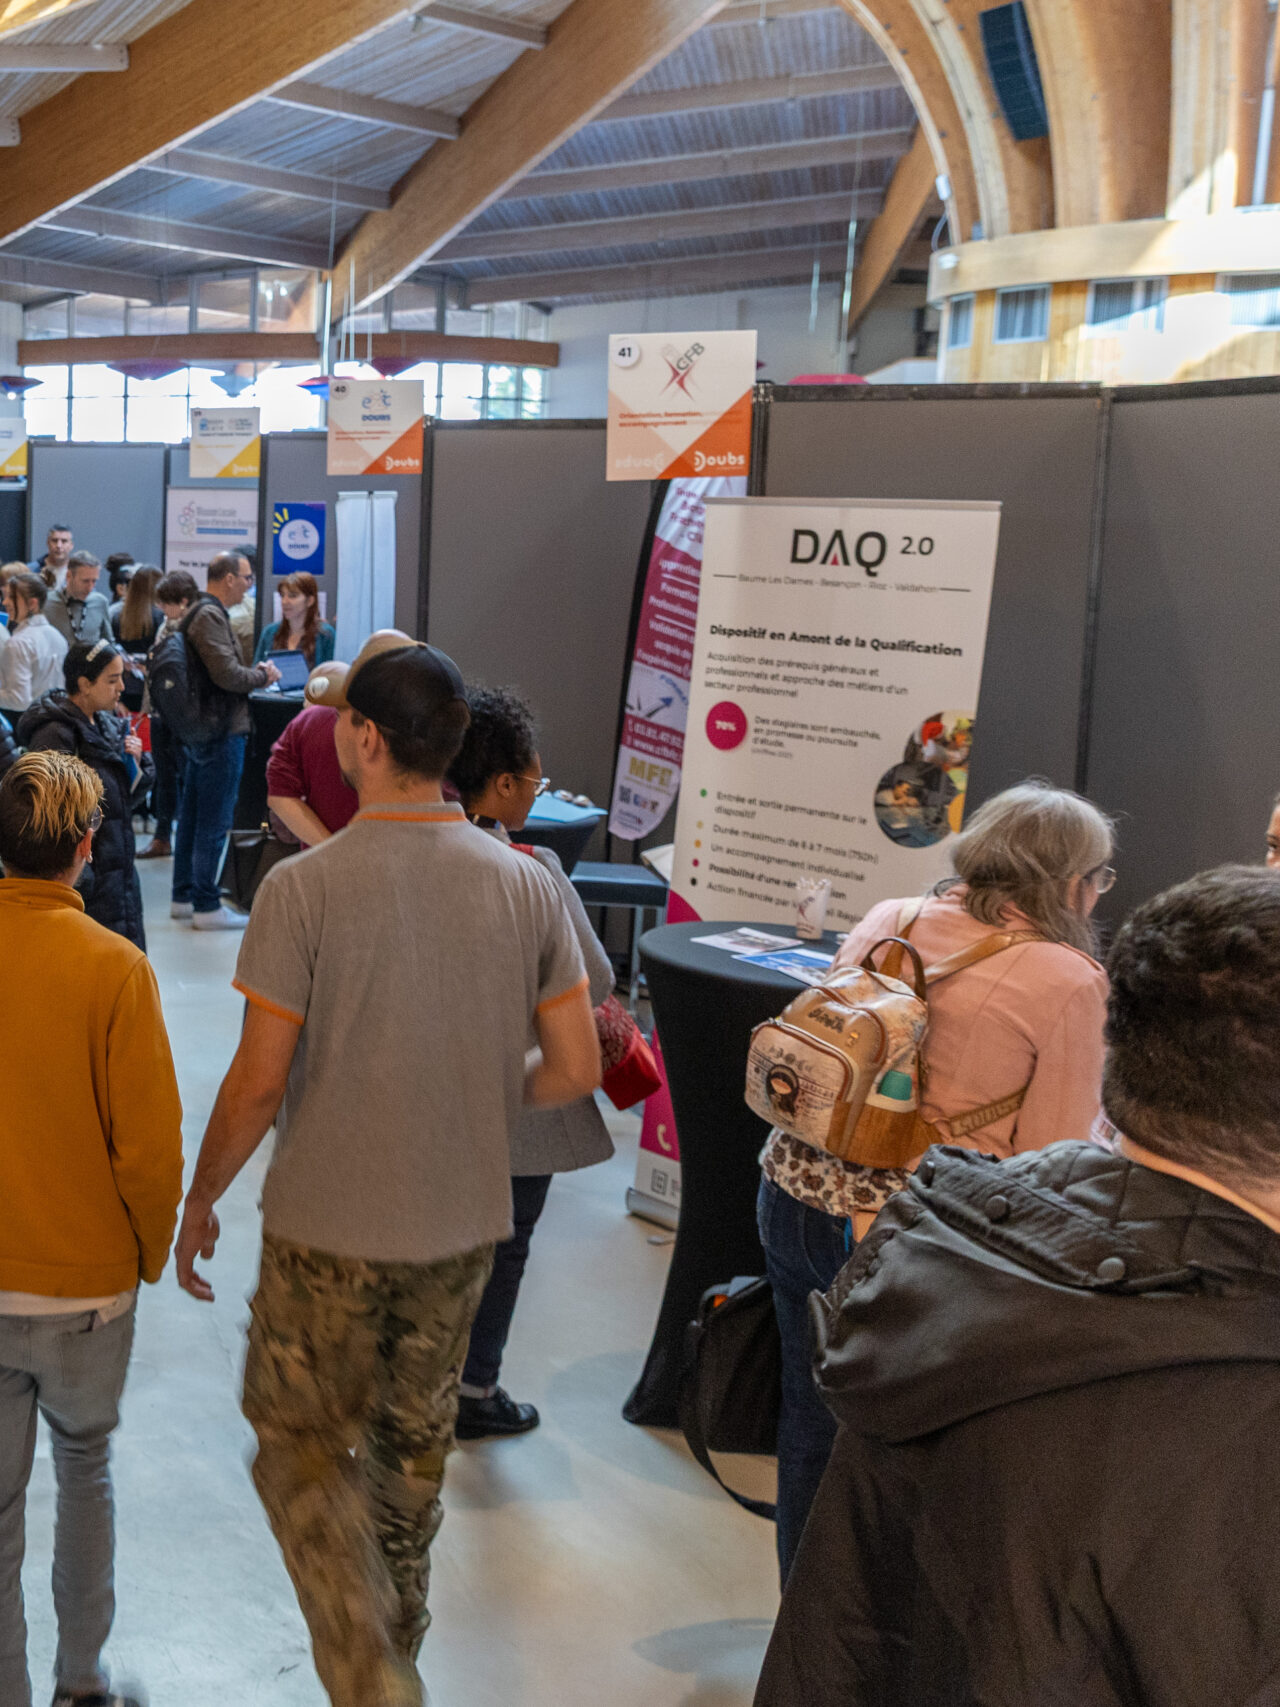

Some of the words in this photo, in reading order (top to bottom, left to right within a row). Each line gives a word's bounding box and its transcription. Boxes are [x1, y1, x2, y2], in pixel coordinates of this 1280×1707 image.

[618, 346, 632, 358] 41
[694, 450, 746, 473] Doubs
[789, 528, 889, 578] DAQ
[899, 535, 936, 557] 2.0
[709, 624, 767, 642] Dispositif
[769, 630, 786, 643] en
[788, 630, 833, 647] Amont
[834, 634, 852, 648] de
[854, 635, 868, 649] la
[870, 637, 964, 658] Qualification
[707, 651, 756, 666] Acquisition
[757, 656, 775, 667] des
[776, 658, 821, 672] prérequis
[822, 662, 867, 677] généraux
[869, 667, 880, 678] et
[704, 679, 736, 691] secteur
[736, 682, 799, 698] professionnel
[705, 664, 769, 681] professionnels
[769, 672, 781, 682] et
[781, 673, 826, 687] approche
[827, 677, 845, 689] des
[846, 679, 884, 693] métiers
[714, 805, 757, 820] dispositif
[716, 790, 747, 805] Entrée
[747, 796, 758, 806] et
[784, 803, 841, 822] permanente
[842, 812, 857, 824] sur
[858, 814, 869, 826] le
[712, 822, 741, 838] Durée
[741, 829, 787, 847] maximum
[787, 837, 801, 849] de
[823, 844, 848, 858] mois
[708, 861, 756, 882] Possibilité
[756, 870, 782, 888] d'une
[710, 842, 724, 853] Un
[725, 846, 806, 871] accompagnement
[806, 859, 867, 884] individualisé
[706, 881, 737, 897] Action
[736, 886, 774, 904] financée
[774, 893, 790, 907] par
